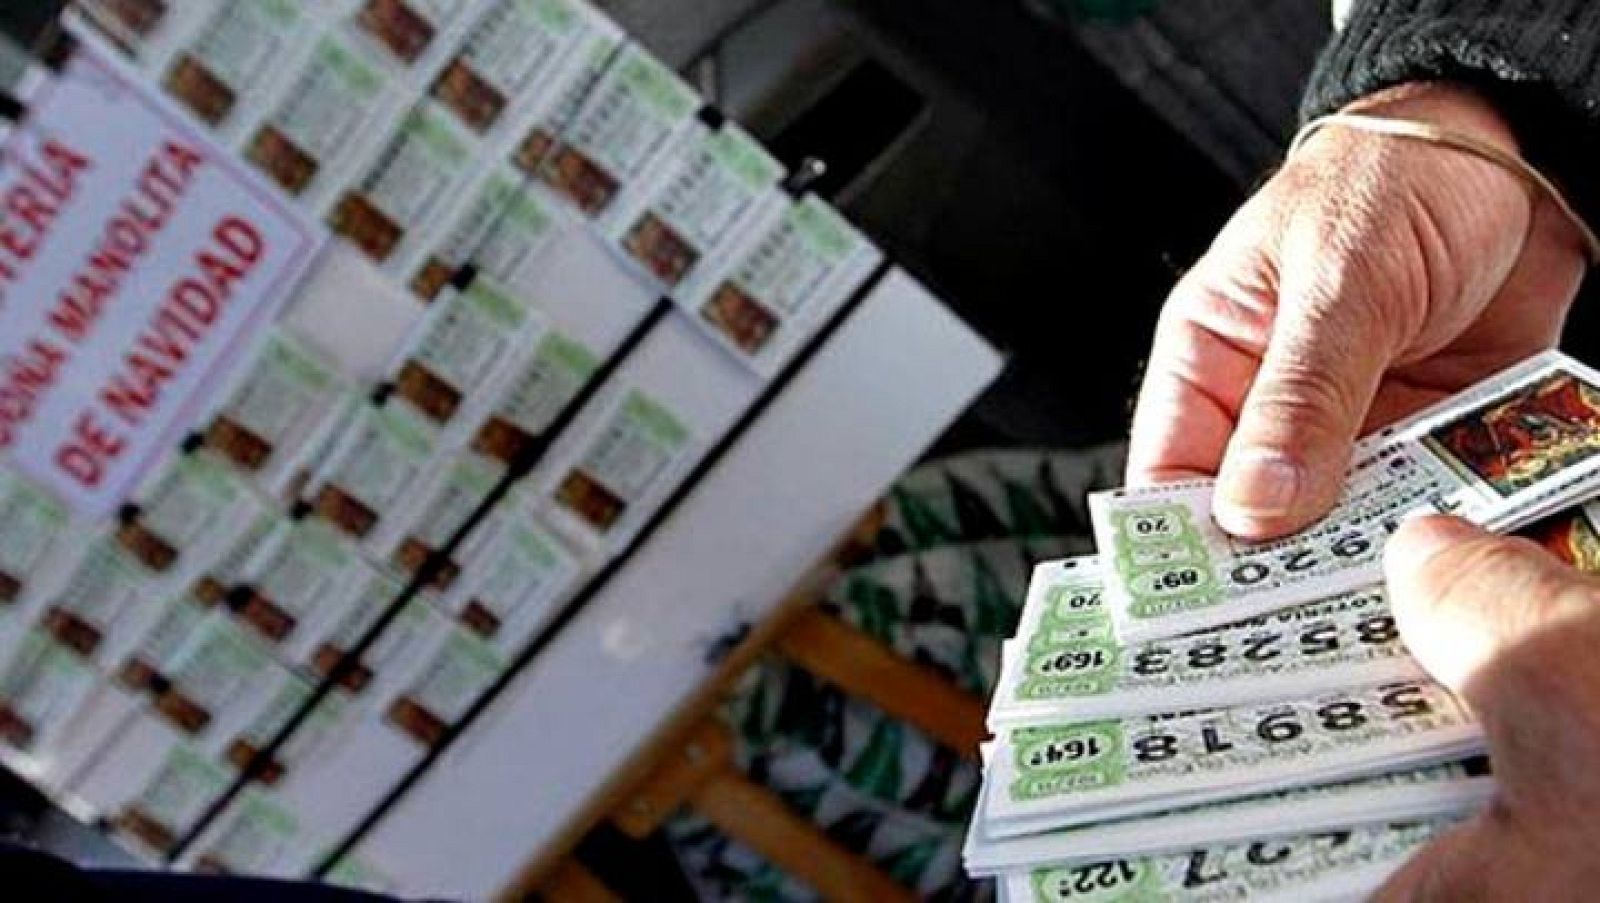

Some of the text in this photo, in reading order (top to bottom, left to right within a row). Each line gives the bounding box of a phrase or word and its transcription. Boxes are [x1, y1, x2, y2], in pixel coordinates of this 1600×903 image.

[47, 140, 204, 342] MANOLITA
[55, 214, 264, 488] DE NAVIDAD
[1133, 614, 1400, 676] 85283
[1133, 686, 1430, 764] 58918
